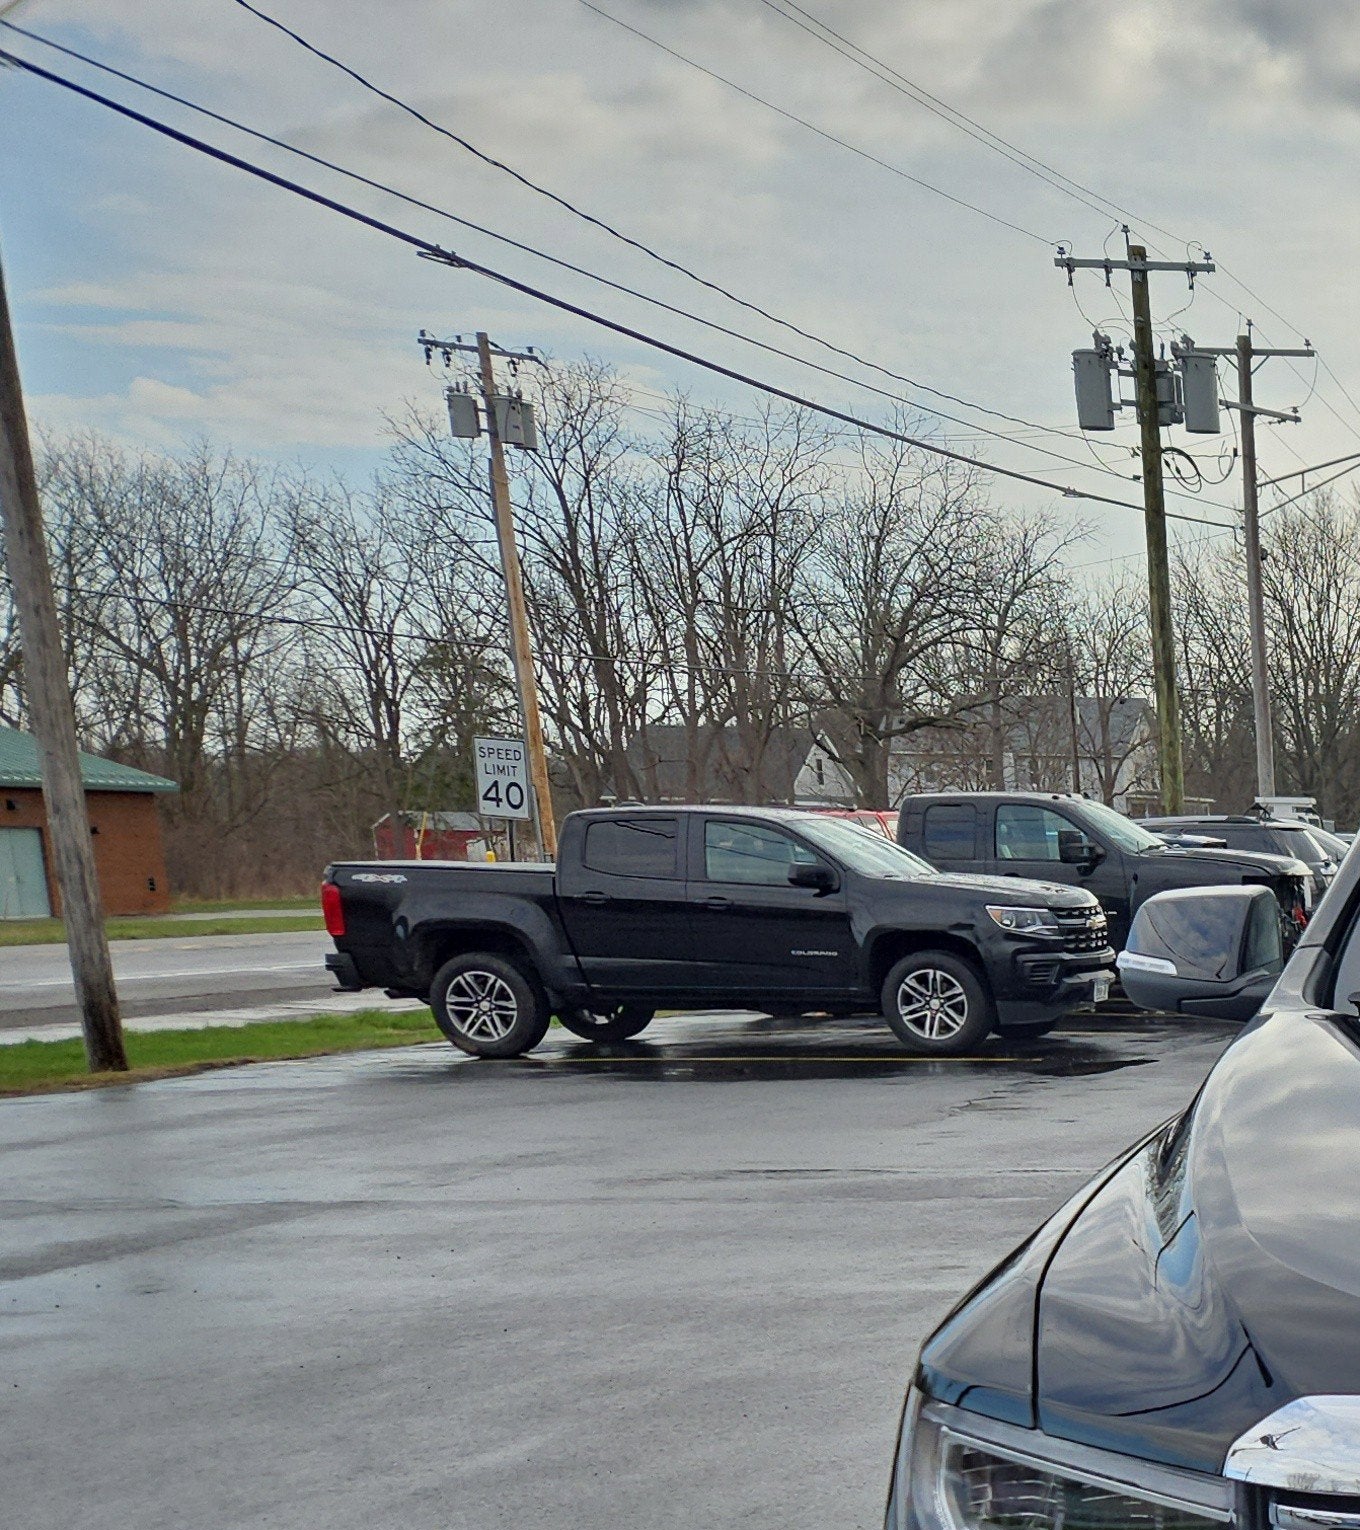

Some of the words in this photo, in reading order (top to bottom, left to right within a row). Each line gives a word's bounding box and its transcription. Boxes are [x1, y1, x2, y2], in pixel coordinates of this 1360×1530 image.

[478, 746, 522, 761] SPEED
[484, 763, 518, 777] LIMIT
[482, 779, 524, 810] 40
